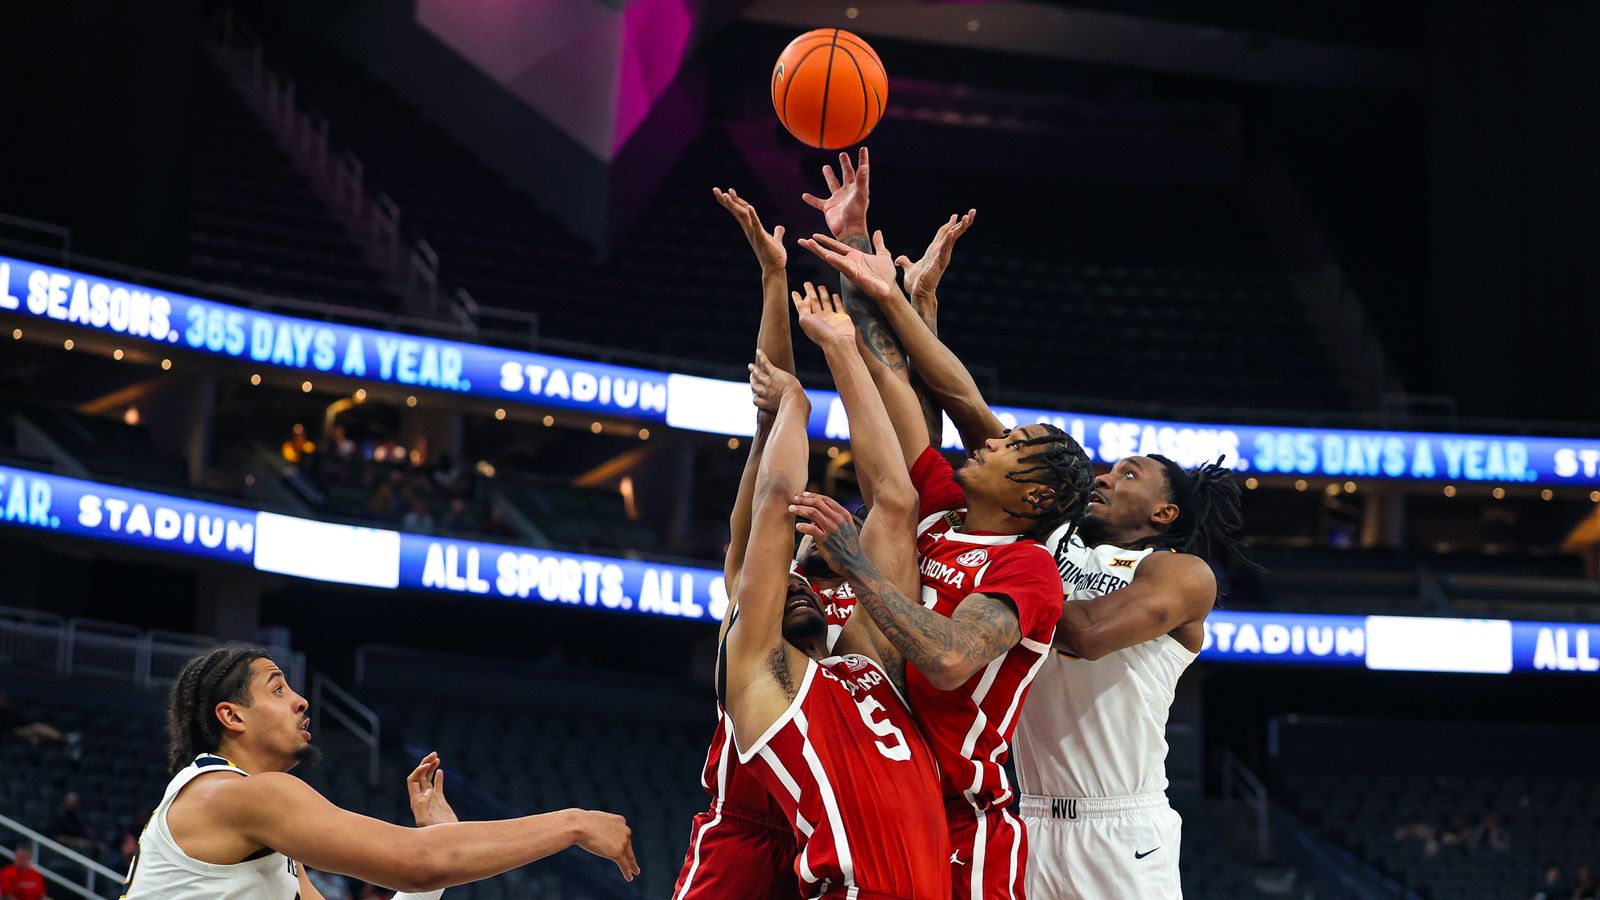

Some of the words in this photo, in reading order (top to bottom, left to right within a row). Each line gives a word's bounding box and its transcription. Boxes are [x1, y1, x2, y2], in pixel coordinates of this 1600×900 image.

[27, 270, 179, 343] SEASONS.
[185, 303, 245, 356] 365
[250, 316, 337, 371] DAYS
[341, 331, 367, 376] A
[375, 334, 472, 392] YEAR.
[500, 361, 667, 413] STADIUM
[1253, 431, 1318, 474] 365
[1321, 434, 1406, 477] DAYS
[1411, 438, 1436, 479] A
[1441, 439, 1538, 483] YEAR.
[77, 494, 254, 554] STADIUM
[421, 542, 490, 594] ALL
[496, 551, 633, 610] SPORTS.
[638, 568, 704, 618] ALL
[1533, 627, 1600, 671] ALL
[853, 694, 912, 761] 5
[1052, 798, 1077, 819] WVU
